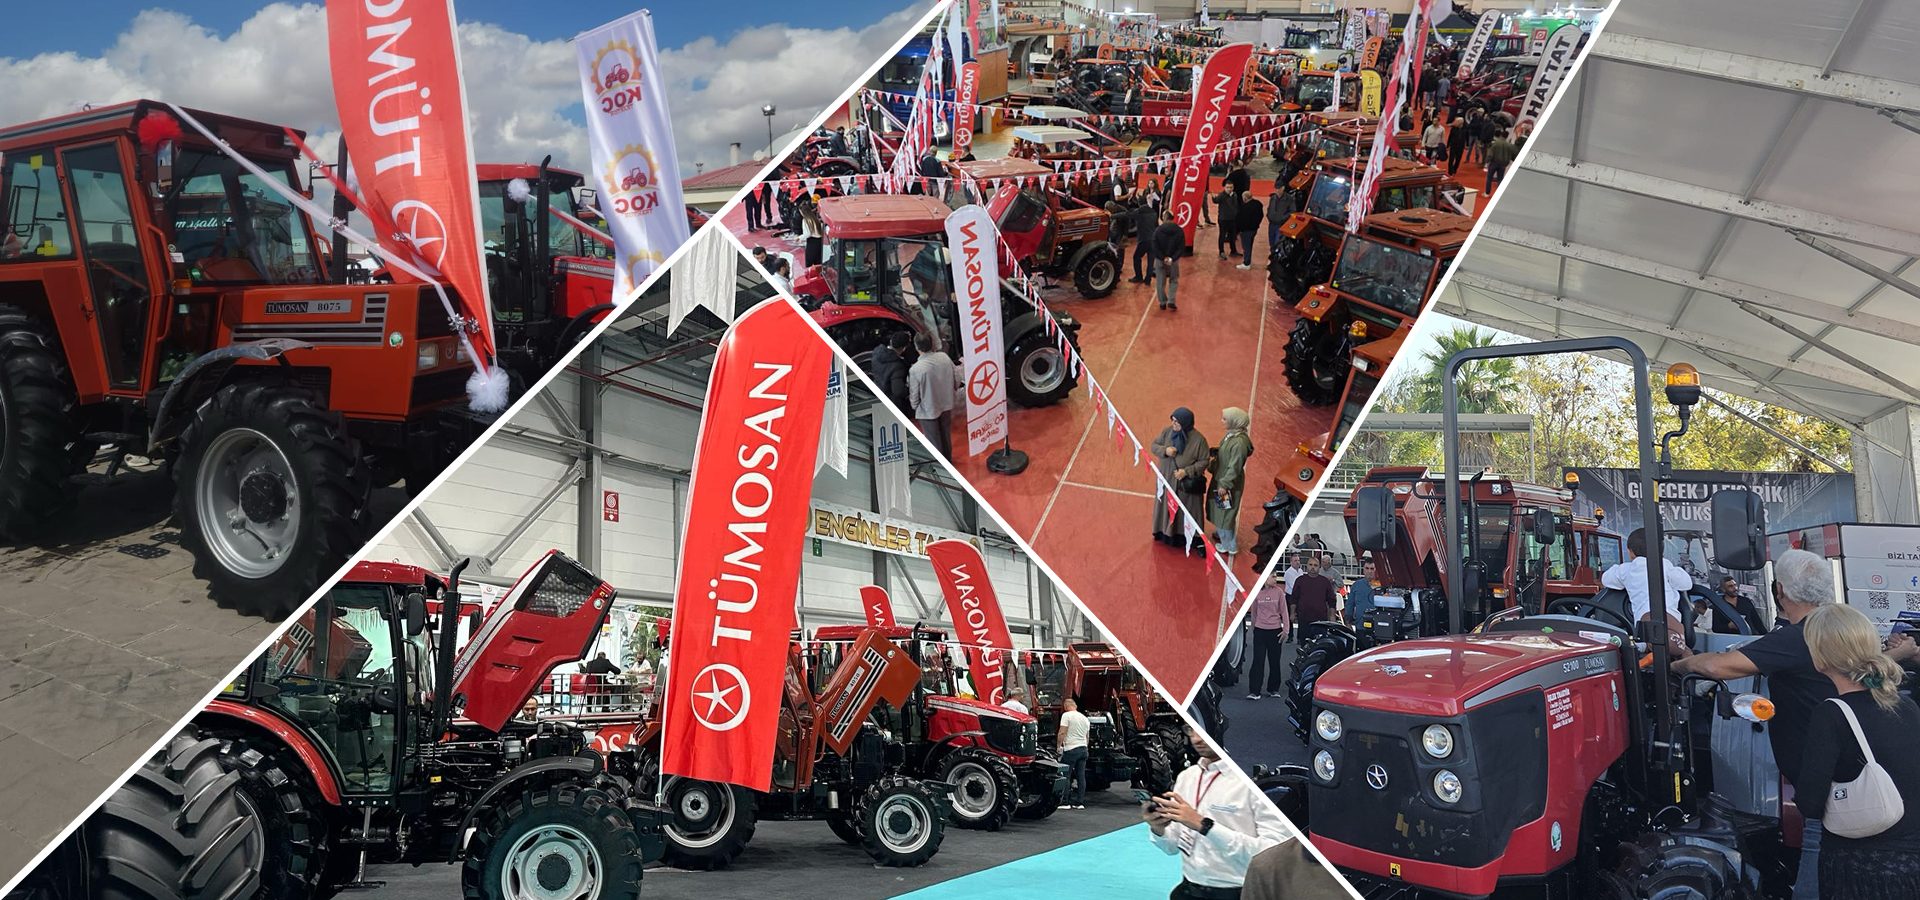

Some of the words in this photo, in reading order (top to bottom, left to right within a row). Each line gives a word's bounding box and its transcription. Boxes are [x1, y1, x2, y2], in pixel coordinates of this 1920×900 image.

[1466, 14, 1495, 64] HATTAT
[1526, 35, 1571, 119] HATTAT
[1183, 73, 1232, 196] TÜMOSAN
[317, 302, 341, 311] 8075
[708, 361, 793, 648] TÜMOSAN
[814, 509, 913, 554] ENGİNLER
[1887, 551, 1905, 560] BİZİ
